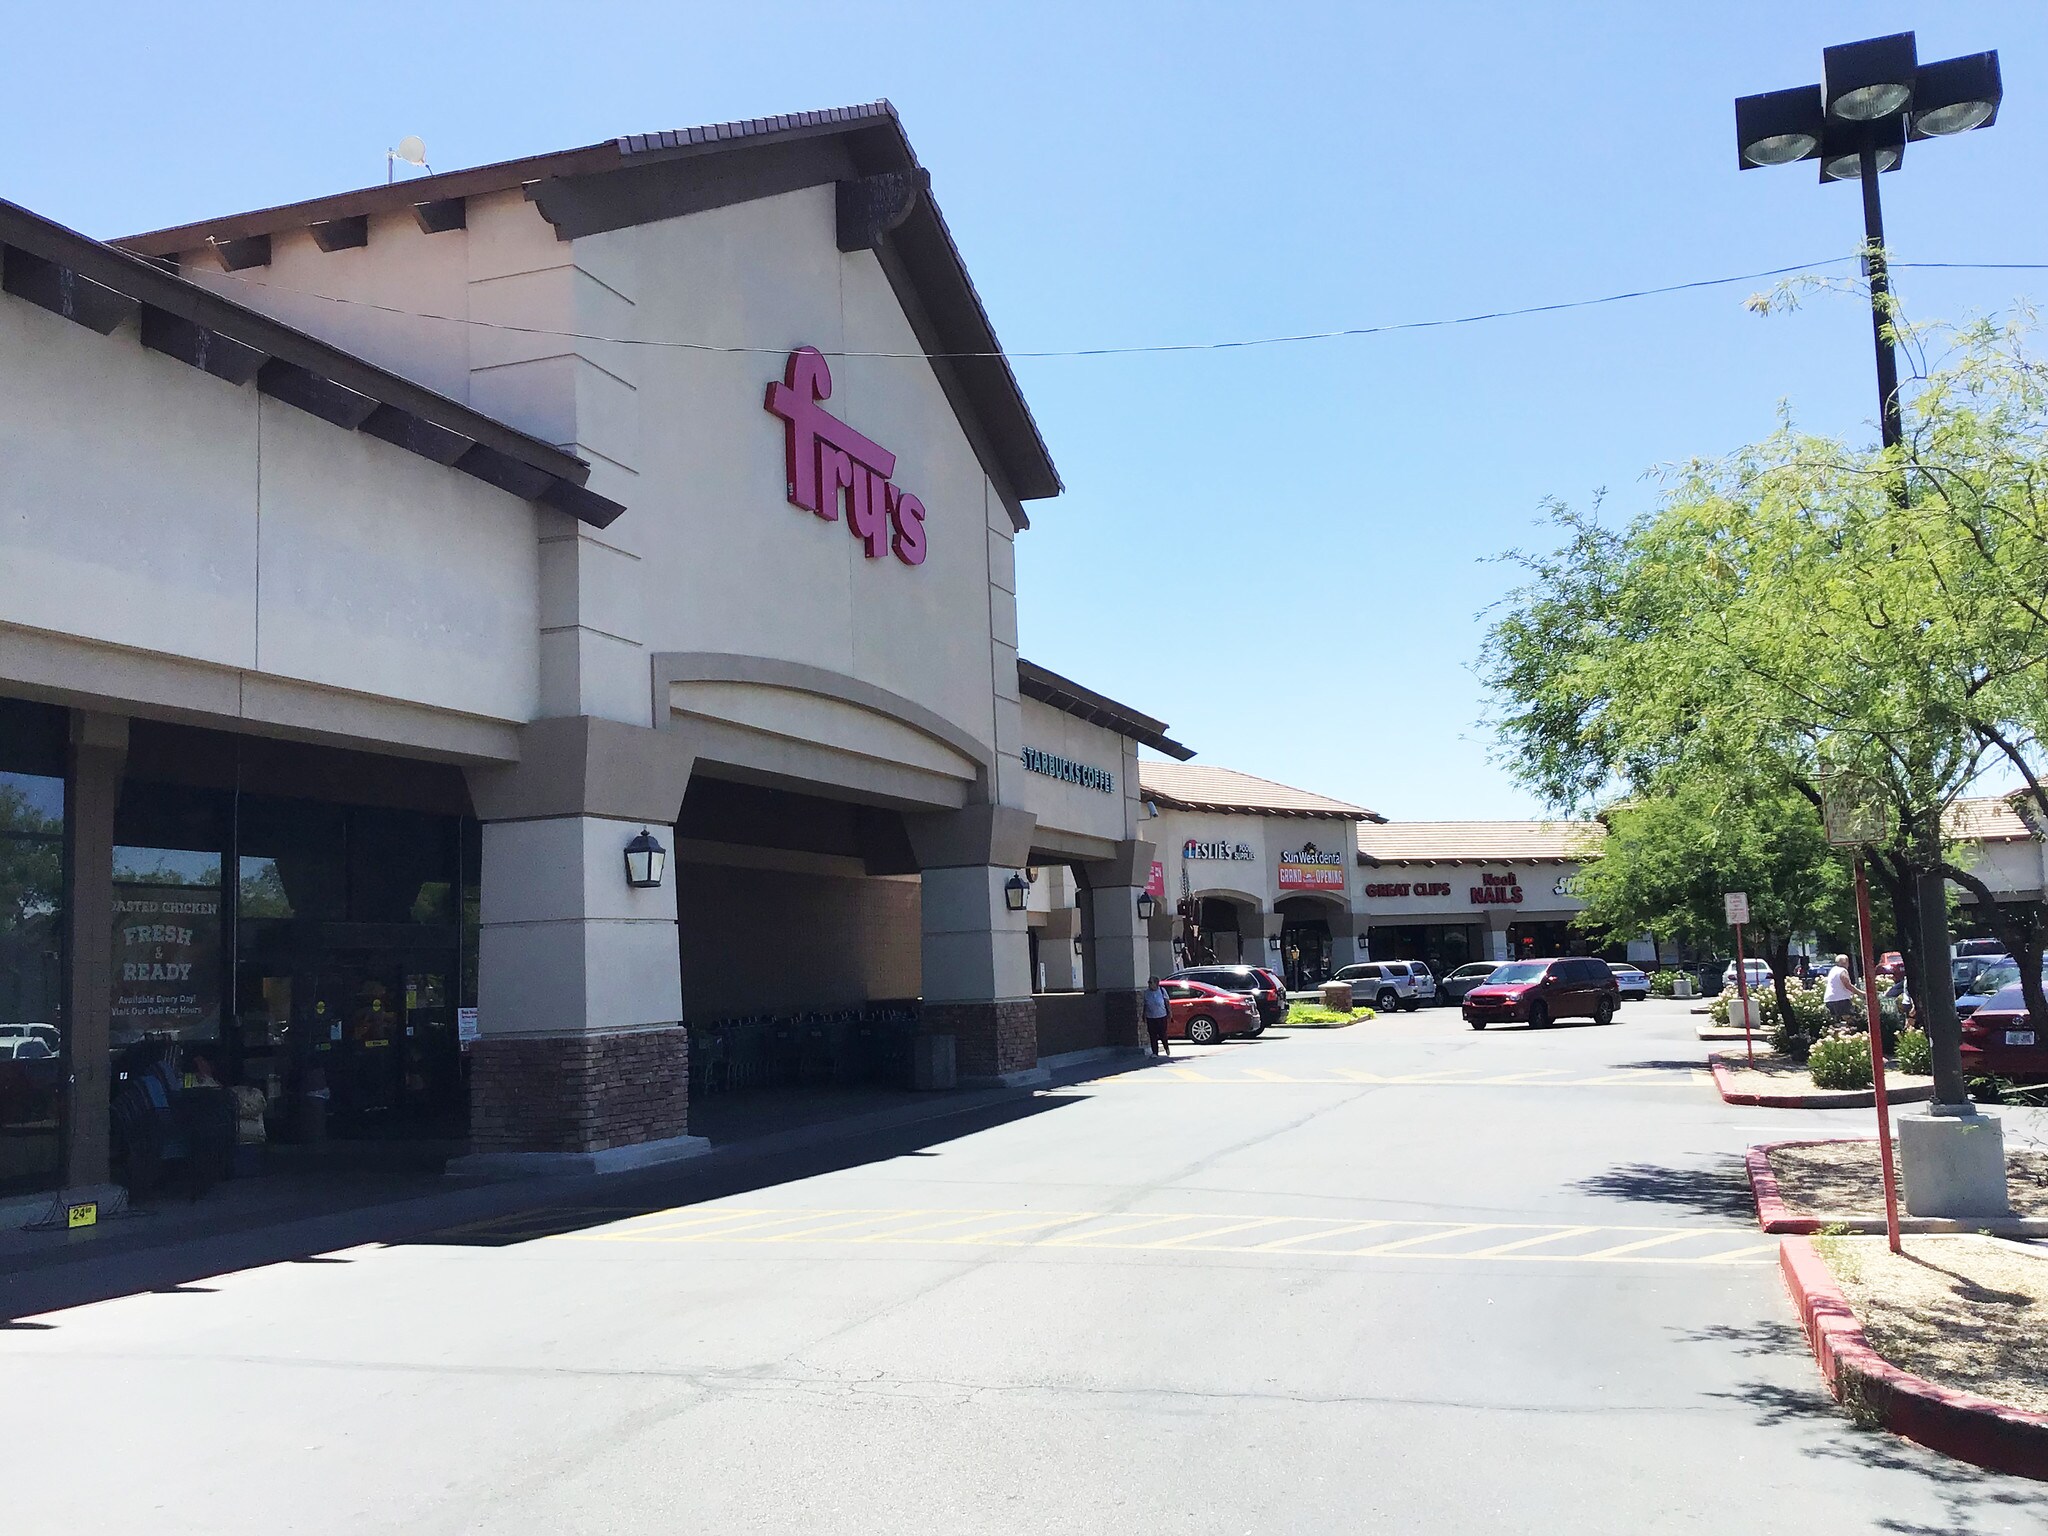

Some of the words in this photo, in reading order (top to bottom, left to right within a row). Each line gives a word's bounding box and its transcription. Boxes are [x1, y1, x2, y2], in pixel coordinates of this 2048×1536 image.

[1020, 745, 1081, 785] STARBUCKS
[1080, 764, 1116, 794] COFFEE
[1187, 841, 1232, 859] LESLIE'S
[1280, 868, 1302, 882] GRAND
[1316, 869, 1343, 884] OPENING
[1366, 884, 1411, 897] GREAT
[1413, 883, 1451, 896] CLIPS
[1470, 886, 1523, 904] NAILS
[162, 902, 217, 914] CHICKEN
[123, 925, 193, 945] FRESH
[155, 946, 163, 959] &
[123, 963, 192, 981] READY
[119, 995, 154, 1004] Available
[156, 995, 178, 1005] Every
